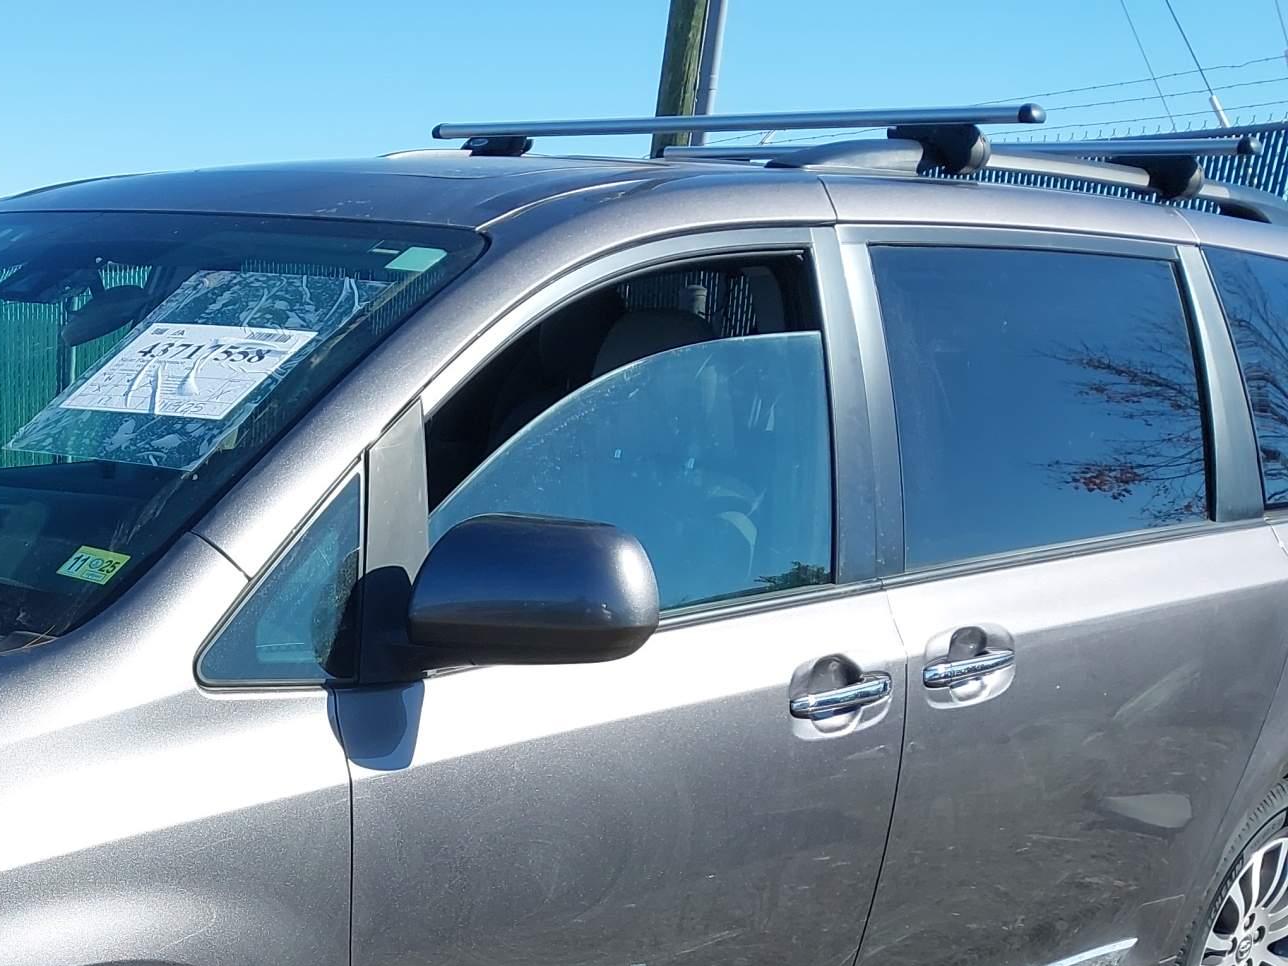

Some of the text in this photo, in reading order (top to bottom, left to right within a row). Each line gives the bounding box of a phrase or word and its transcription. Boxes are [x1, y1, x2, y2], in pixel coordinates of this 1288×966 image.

[138, 342, 272, 364] 43717558
[67, 554, 121, 574] 11 25
